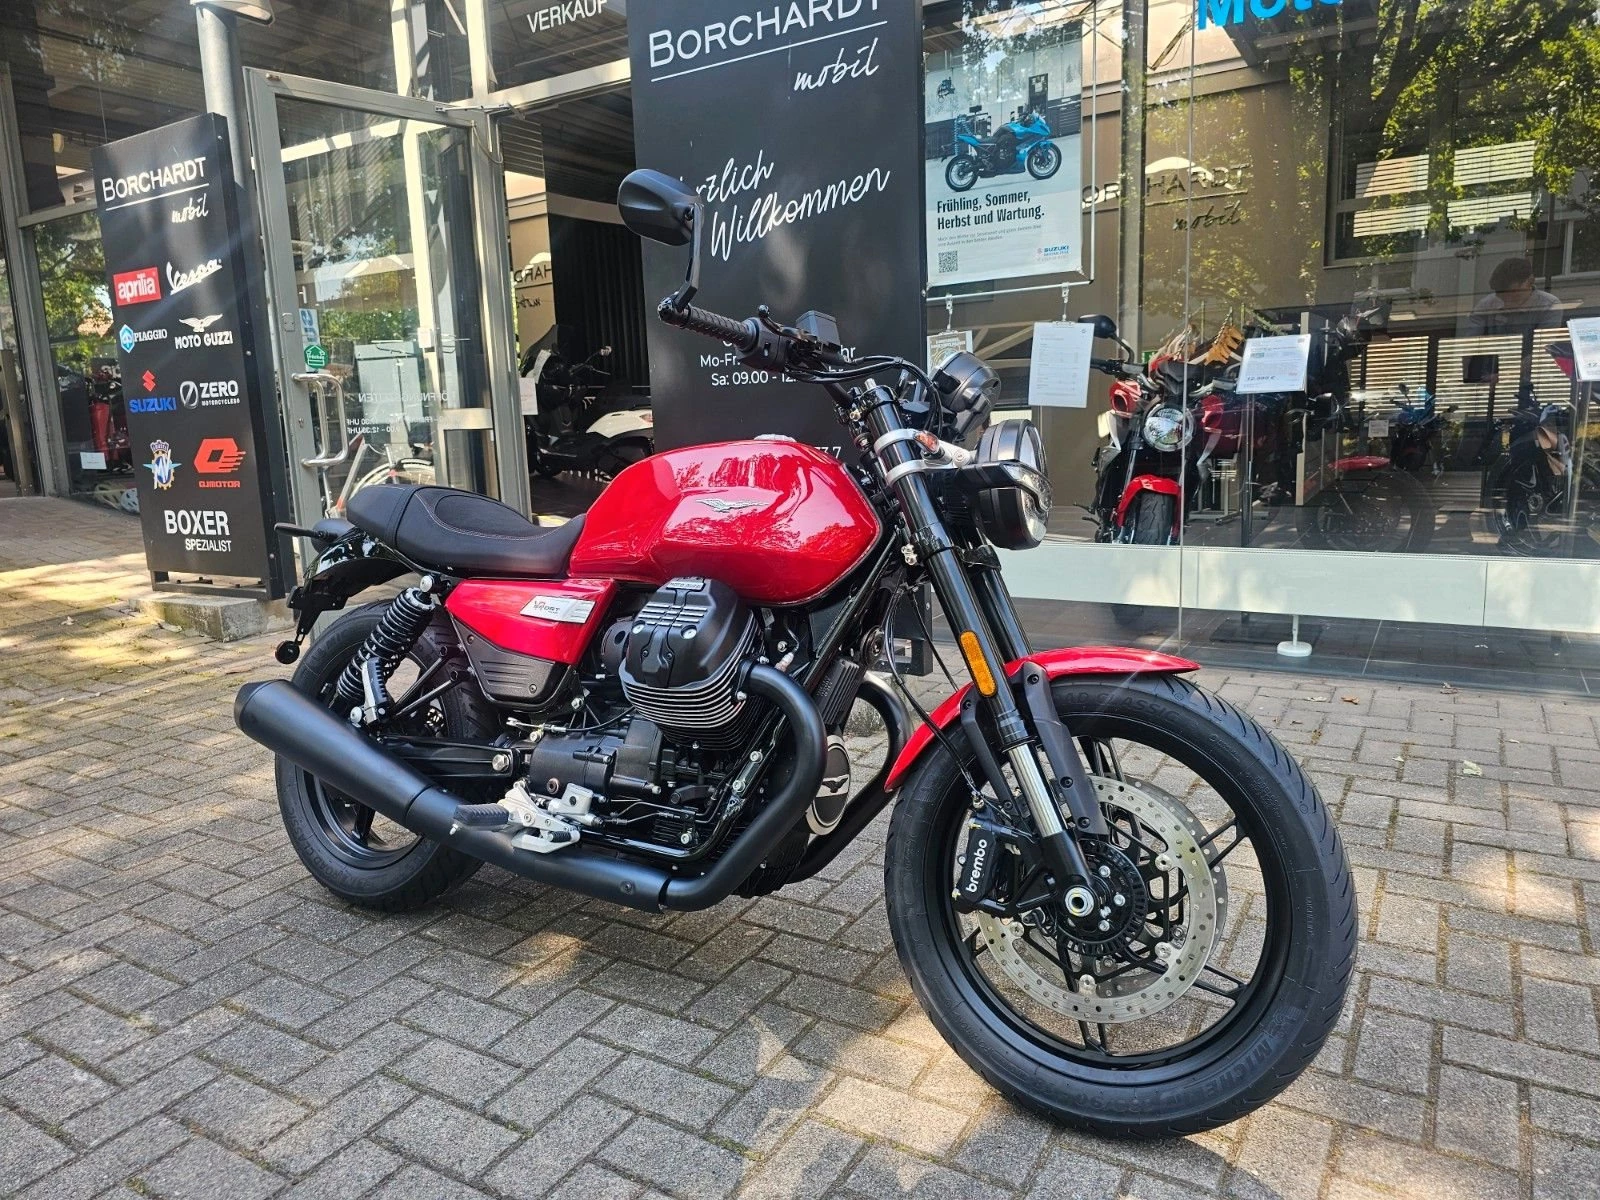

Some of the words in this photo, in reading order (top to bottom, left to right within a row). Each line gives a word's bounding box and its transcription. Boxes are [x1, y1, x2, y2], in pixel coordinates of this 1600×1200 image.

[793, 37, 880, 91] mobil
[101, 156, 207, 201] BORCHARDT
[695, 149, 774, 202] rzlich
[711, 167, 891, 262] Willkommen
[936, 196, 983, 214] Frühling,
[985, 190, 1031, 208] Sommer,
[937, 213, 972, 230] Herbst
[974, 210, 994, 226] und
[996, 204, 1045, 222] Wartung.
[118, 272, 156, 302] aprilia
[166, 259, 222, 295] Vespa
[133, 328, 168, 343] PIAGGIO
[175, 335, 202, 350] MOTO
[204, 331, 233, 346] GUZZI
[200, 380, 239, 398] ZERO
[711, 373, 730, 386] Sa:
[732, 371, 769, 385] 09.00
[129, 397, 177, 413] SUZUKI
[198, 480, 241, 488] QJMOTOR
[164, 510, 231, 536] BOXER
[185, 538, 232, 552] SPEZIALIST
[965, 839, 987, 893] brembo
